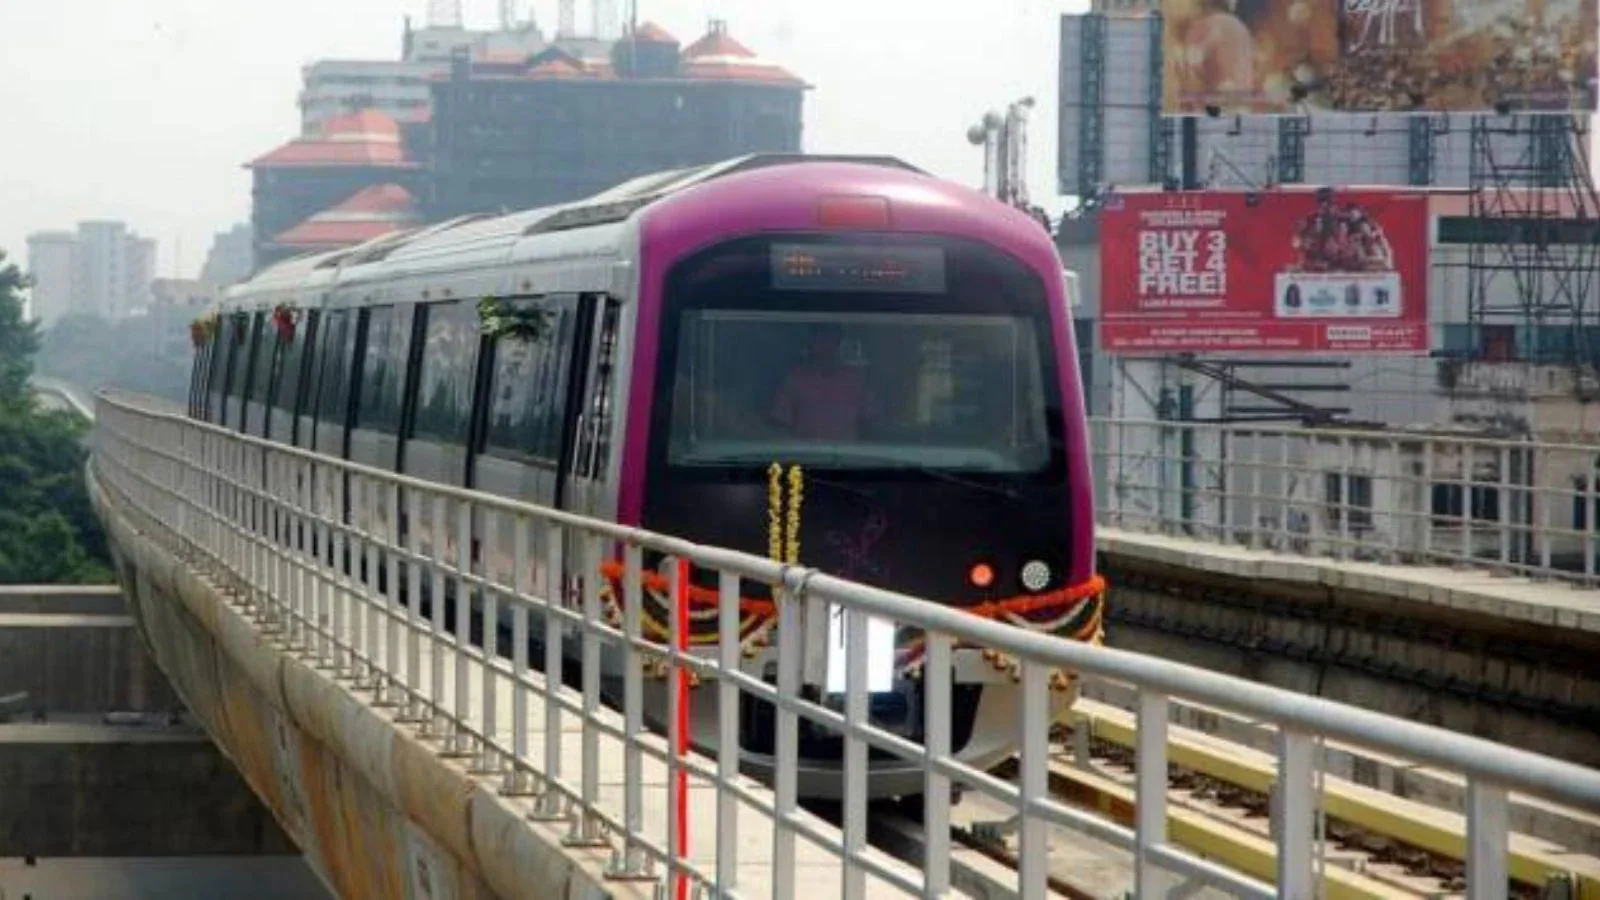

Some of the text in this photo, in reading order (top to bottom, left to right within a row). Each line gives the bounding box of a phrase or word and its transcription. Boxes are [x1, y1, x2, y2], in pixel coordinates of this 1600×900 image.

[1139, 230, 1226, 250] BUY 3
[1139, 250, 1226, 272] GET 4
[1139, 271, 1226, 295] FREE!
